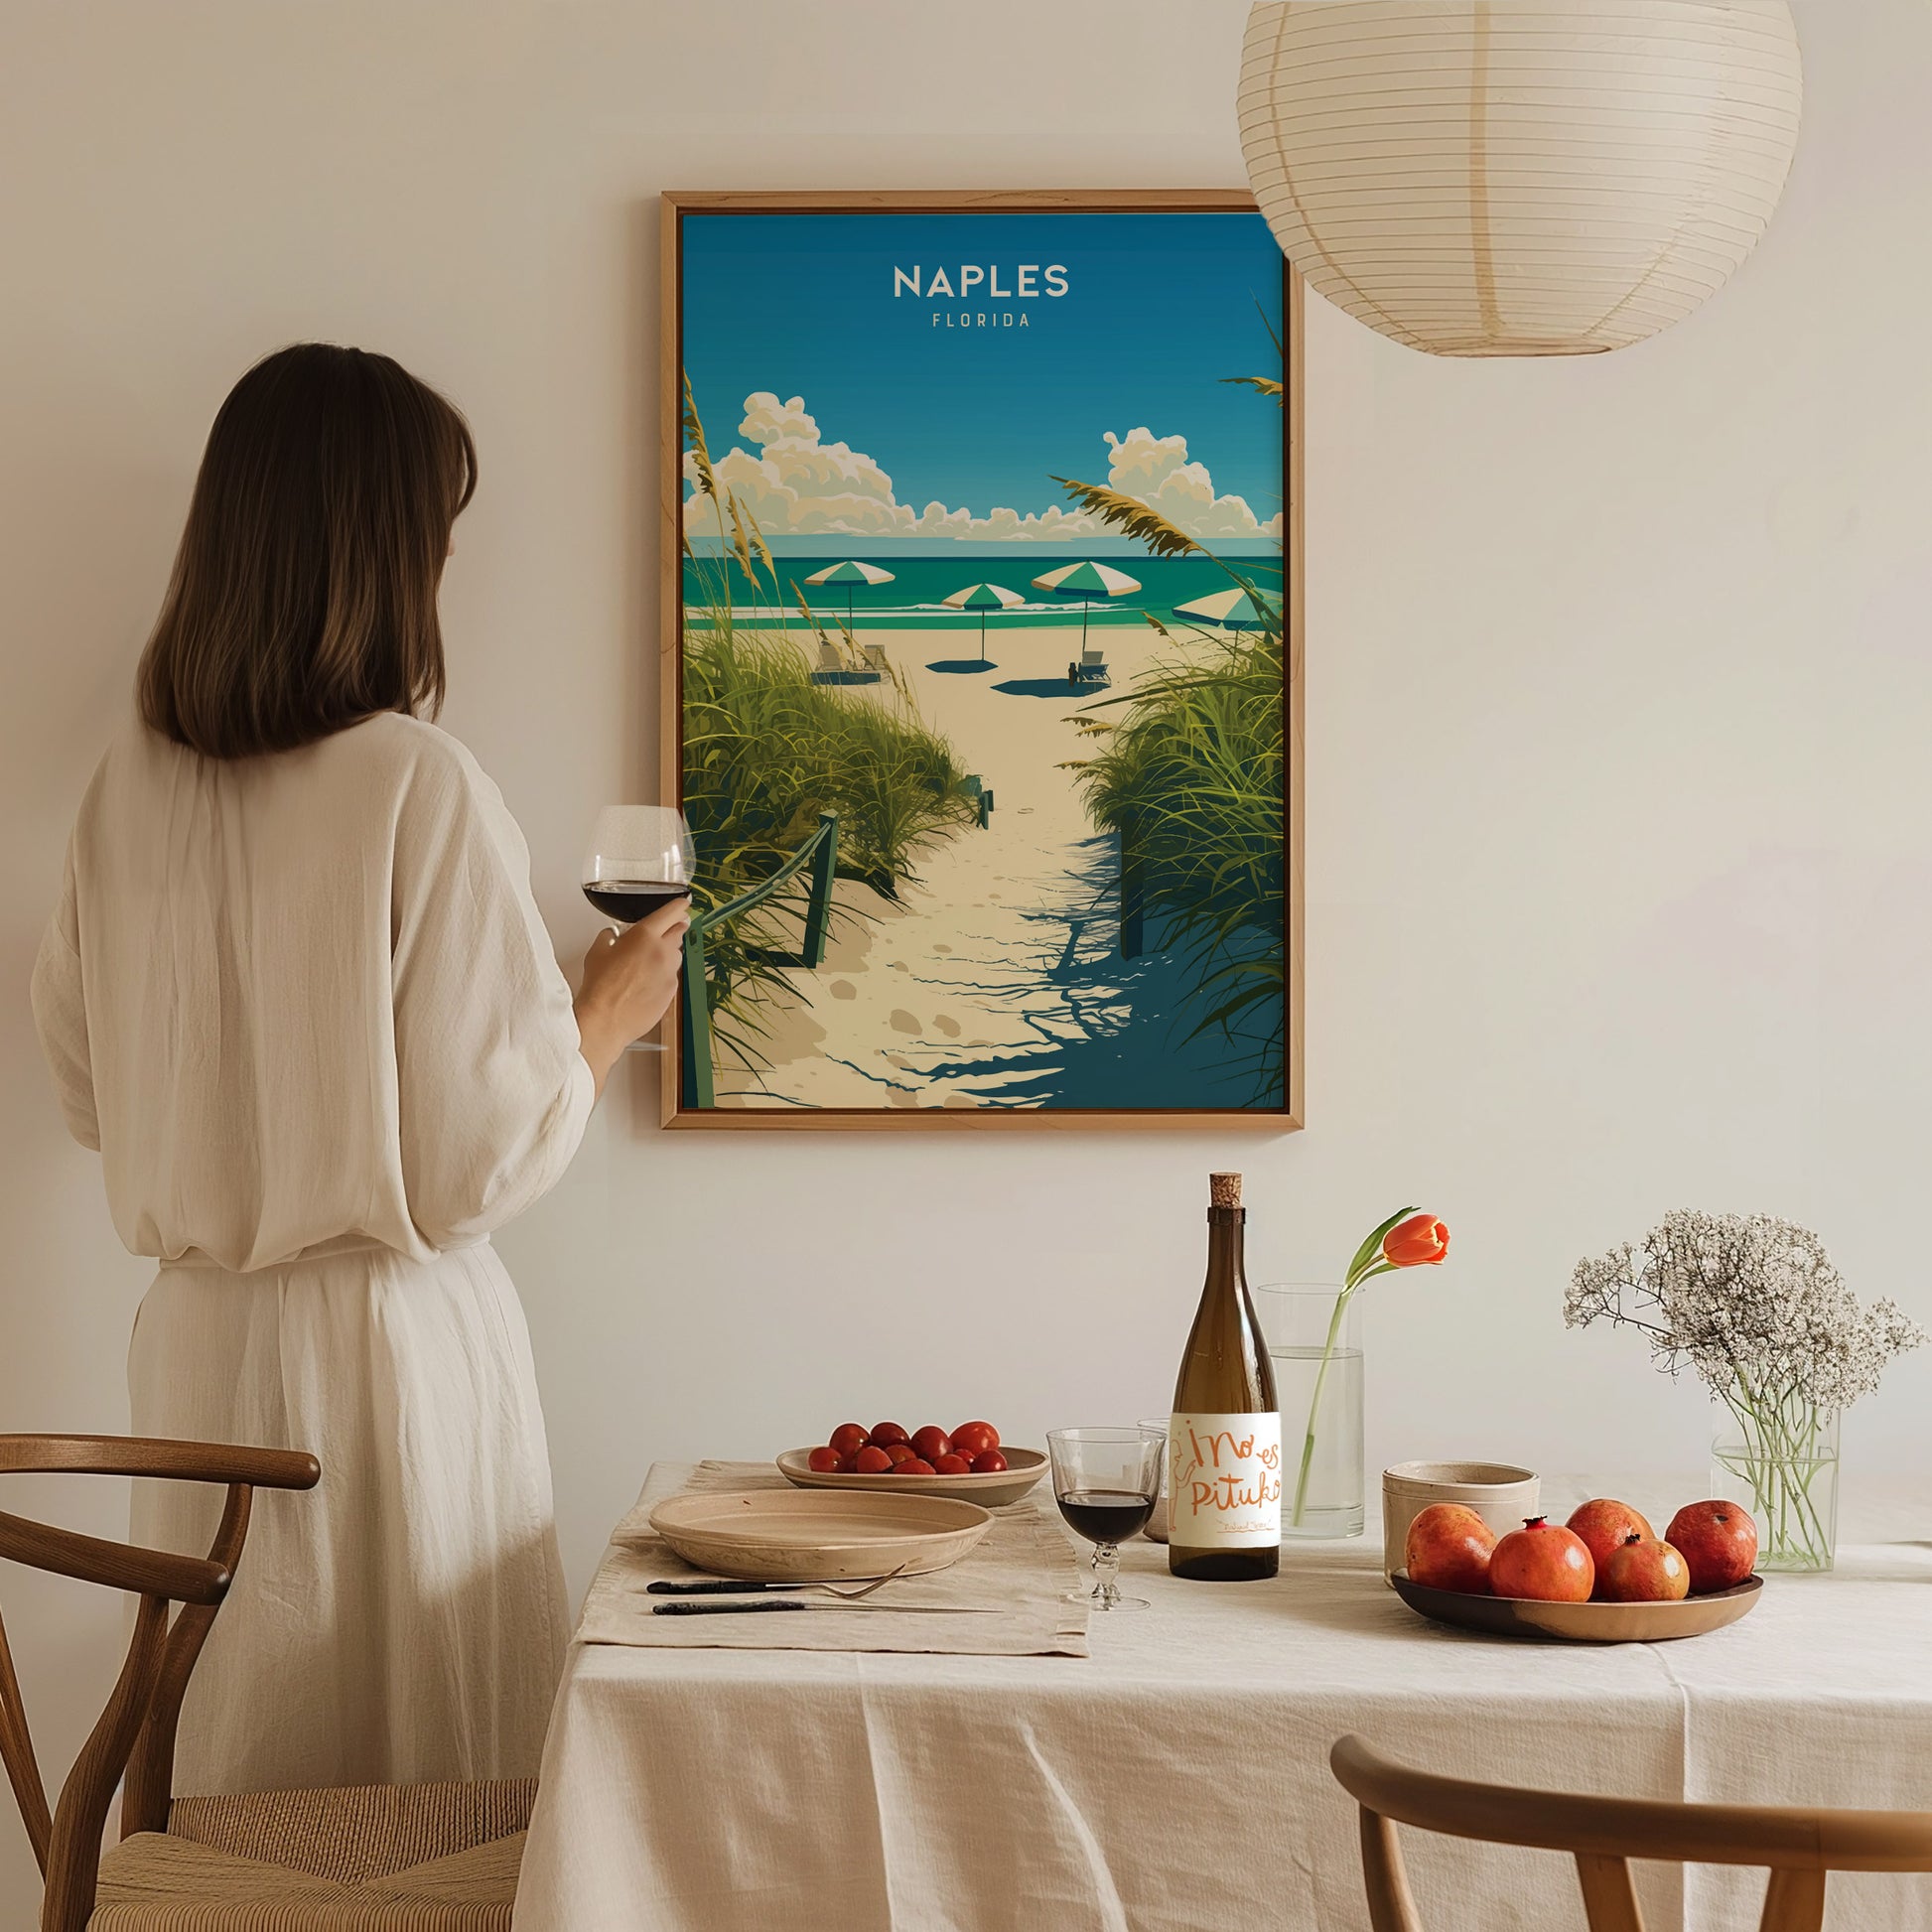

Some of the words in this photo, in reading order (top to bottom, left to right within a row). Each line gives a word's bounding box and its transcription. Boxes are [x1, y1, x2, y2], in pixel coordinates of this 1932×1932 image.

[894, 264, 1069, 298] NAPLES
[932, 313, 1030, 328] FLORIDA
[1256, 1444, 1279, 1469] es
